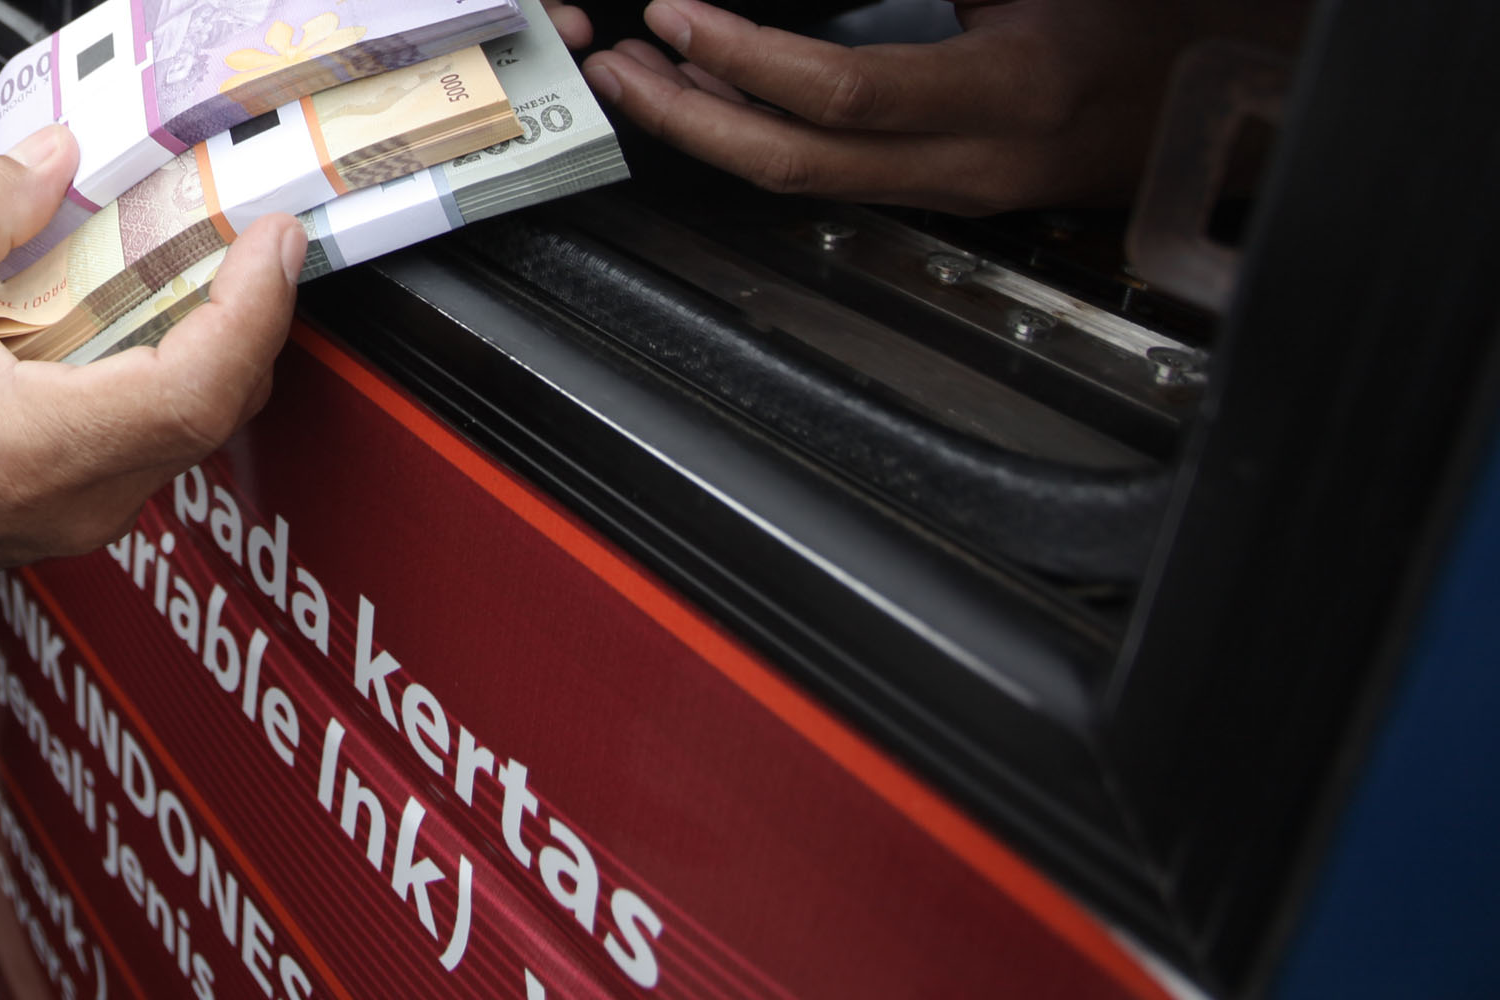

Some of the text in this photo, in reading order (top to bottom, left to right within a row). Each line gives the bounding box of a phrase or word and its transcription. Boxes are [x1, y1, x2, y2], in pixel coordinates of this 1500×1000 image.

[440, 74, 469, 103] 5000
[453, 104, 573, 168] 00
[174, 465, 663, 989] pada kertas
[102, 801, 215, 1000] jenis
[318, 717, 473, 972] Ink)
